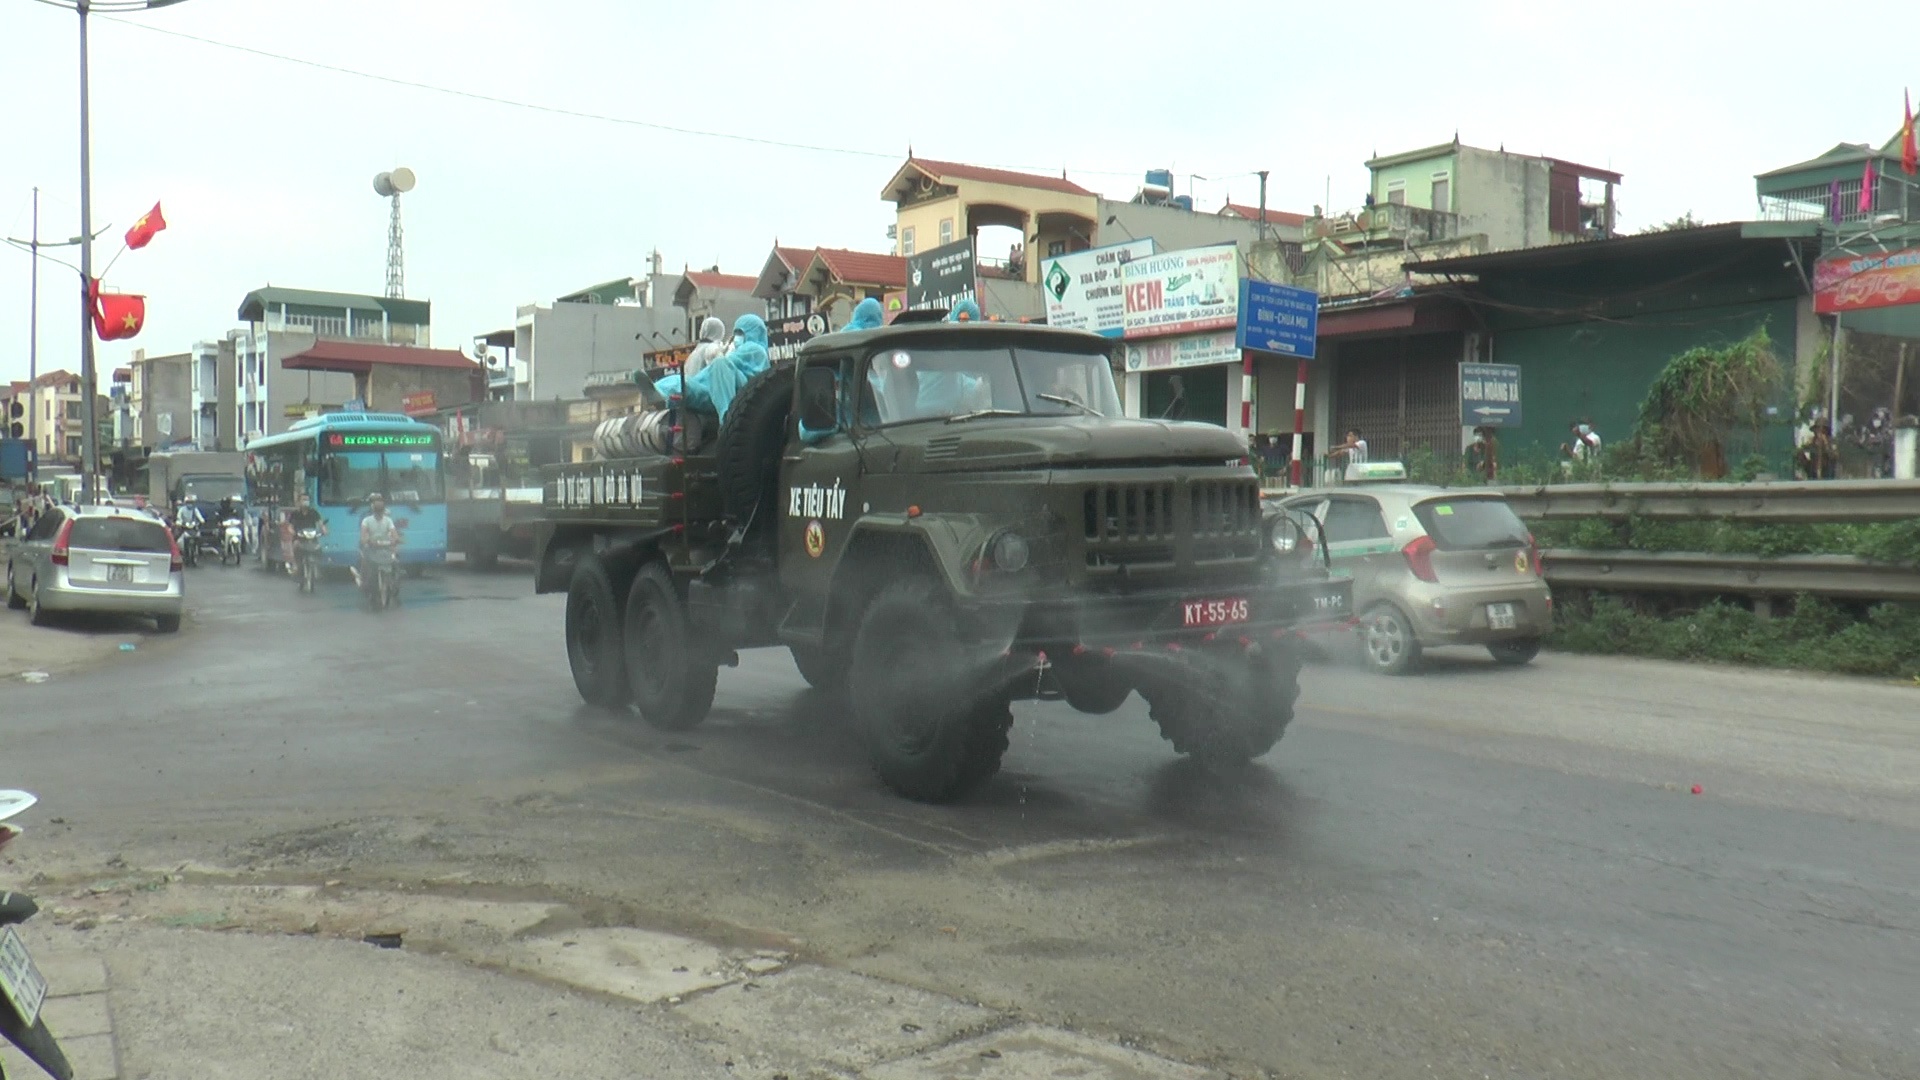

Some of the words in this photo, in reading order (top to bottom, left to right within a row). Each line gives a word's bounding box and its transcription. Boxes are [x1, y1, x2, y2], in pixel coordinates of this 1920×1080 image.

[1125, 279, 1163, 314] KEM
[789, 486, 802, 517] XE
[803, 482, 824, 518] TIÊU
[826, 476, 846, 520] TẨY
[1184, 600, 1248, 624] KT-55-65
